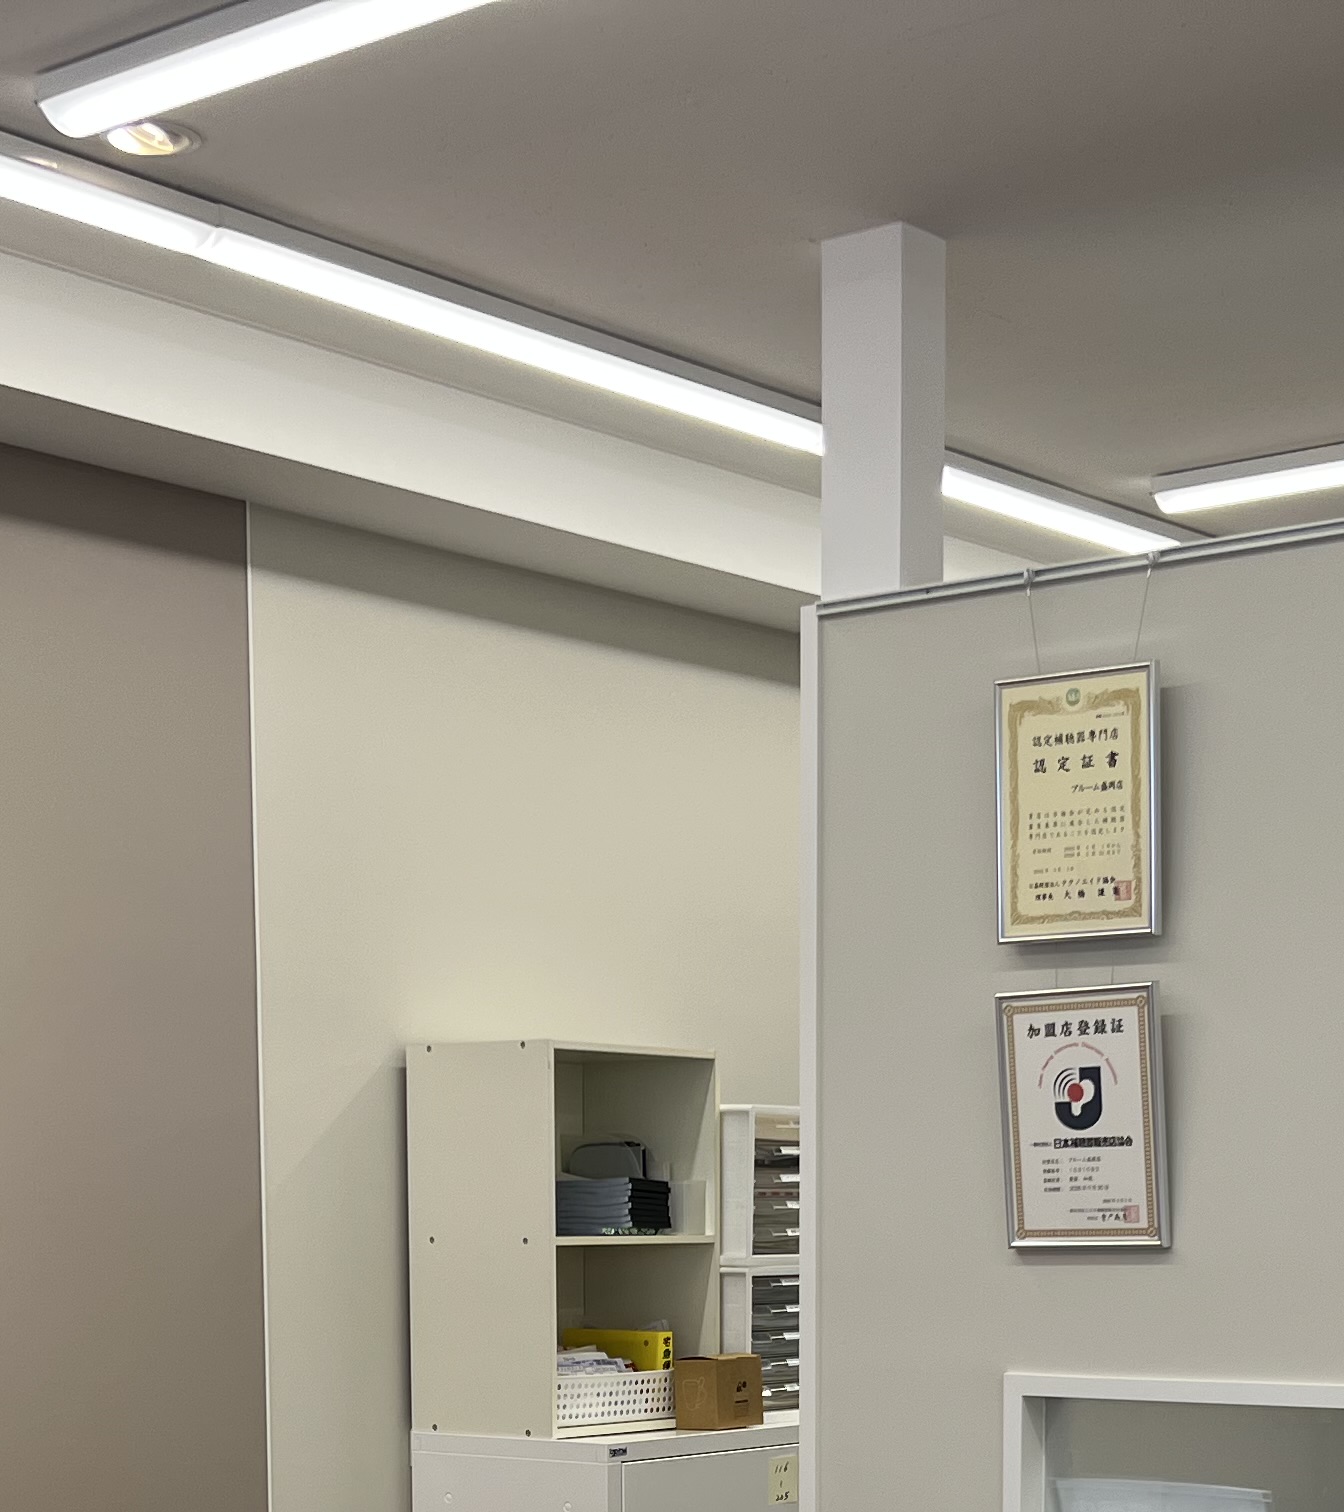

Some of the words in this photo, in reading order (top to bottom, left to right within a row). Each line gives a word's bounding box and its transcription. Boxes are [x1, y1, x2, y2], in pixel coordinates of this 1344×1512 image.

[1033, 750, 1119, 773] 認定証書
[1027, 1017, 1125, 1039] 加盟店登録証
